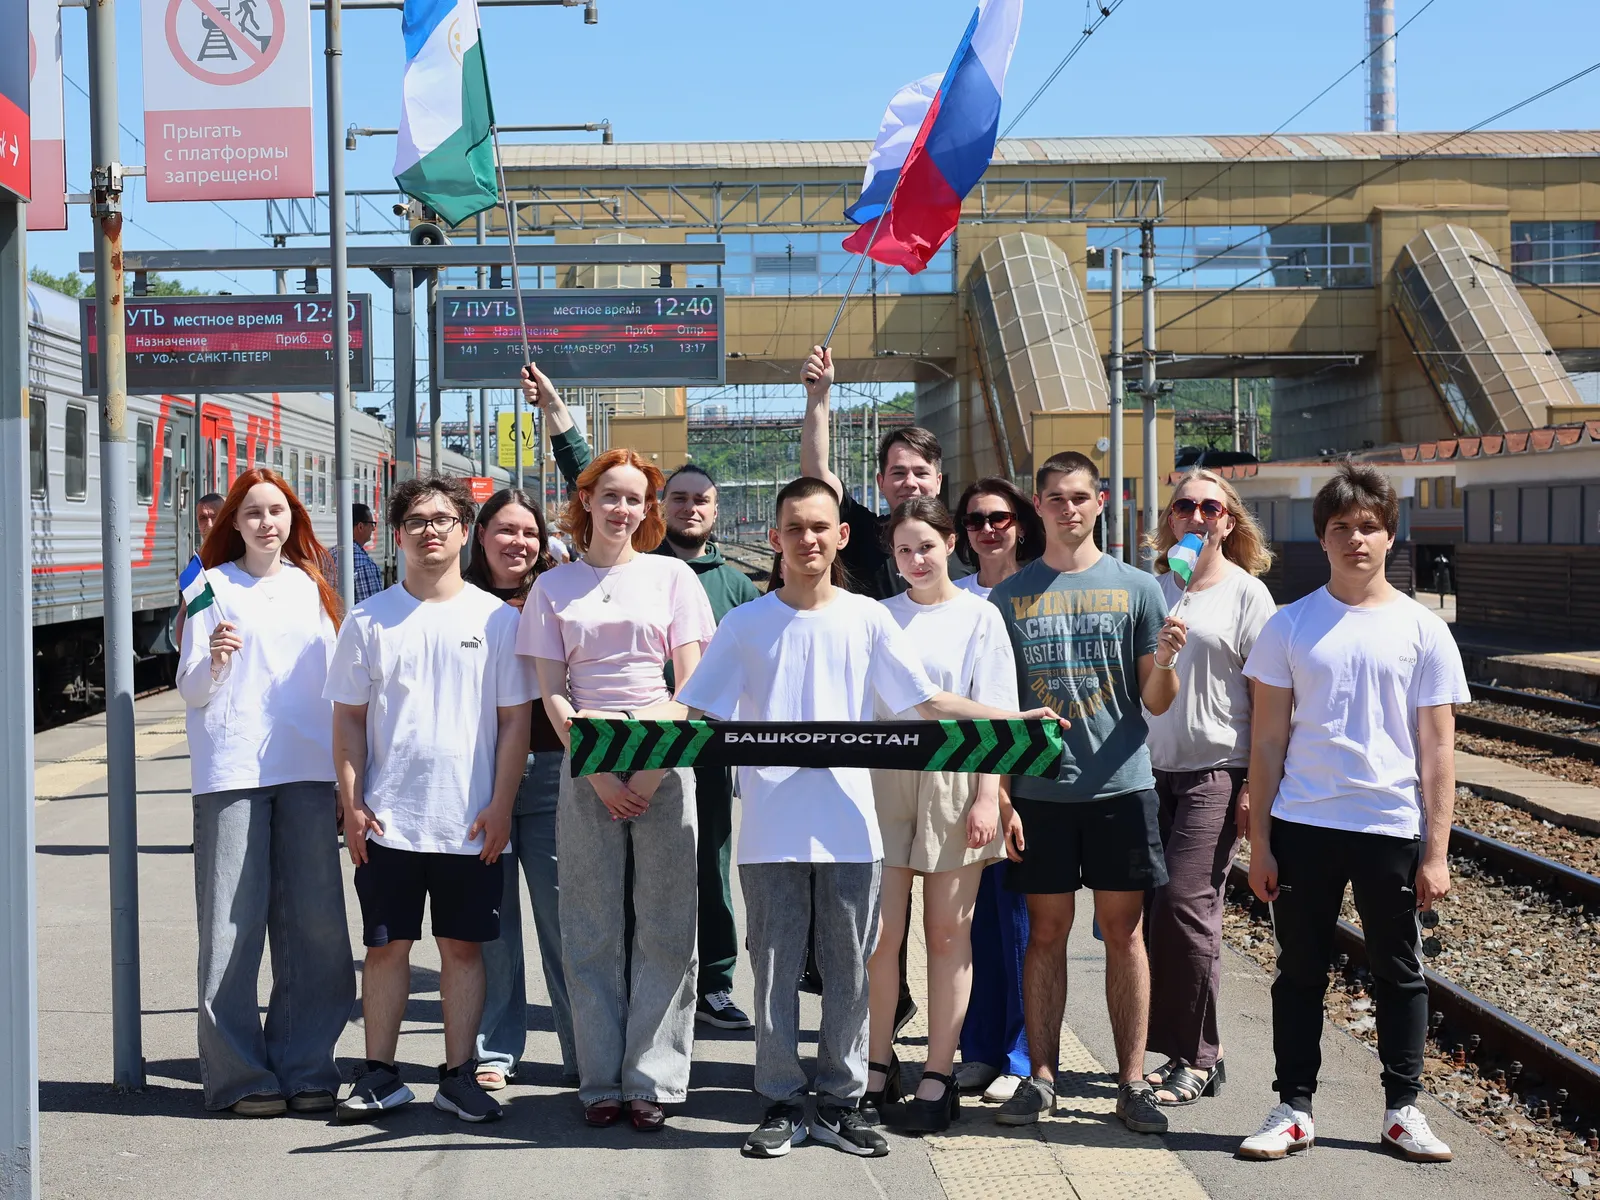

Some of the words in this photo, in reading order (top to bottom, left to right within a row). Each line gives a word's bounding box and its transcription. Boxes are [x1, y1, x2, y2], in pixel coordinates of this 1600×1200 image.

[163, 123, 242, 143] Прыгать
[164, 149, 173, 161] с
[178, 144, 288, 164] платформы
[165, 165, 278, 186] запрещено!
[450, 301, 460, 317] 7
[467, 301, 516, 317] ПУТЬ
[553, 306, 602, 315] местное
[604, 305, 641, 318] время
[654, 297, 713, 316] 12:40
[126, 309, 165, 326] УТЬ
[173, 315, 234, 327] местное
[238, 314, 283, 328] время
[494, 326, 559, 336] Назнчение
[625, 324, 657, 337] Приб.
[677, 324, 707, 336] Отпр.
[135, 336, 208, 347] Назначение
[275, 333, 311, 347] Приб.
[460, 345, 478, 354] 141
[628, 344, 654, 353] 12:51
[680, 343, 706, 353] 13:17
[188, 351, 271, 363] САНКТ-ПЕТЕР
[1011, 589, 1129, 620] WINNER
[1025, 613, 1114, 638] CHAMPS
[460, 641, 479, 649] PUMA
[1047, 678, 1060, 690] 19
[724, 732, 920, 746] БАШКОРТОСТАН
